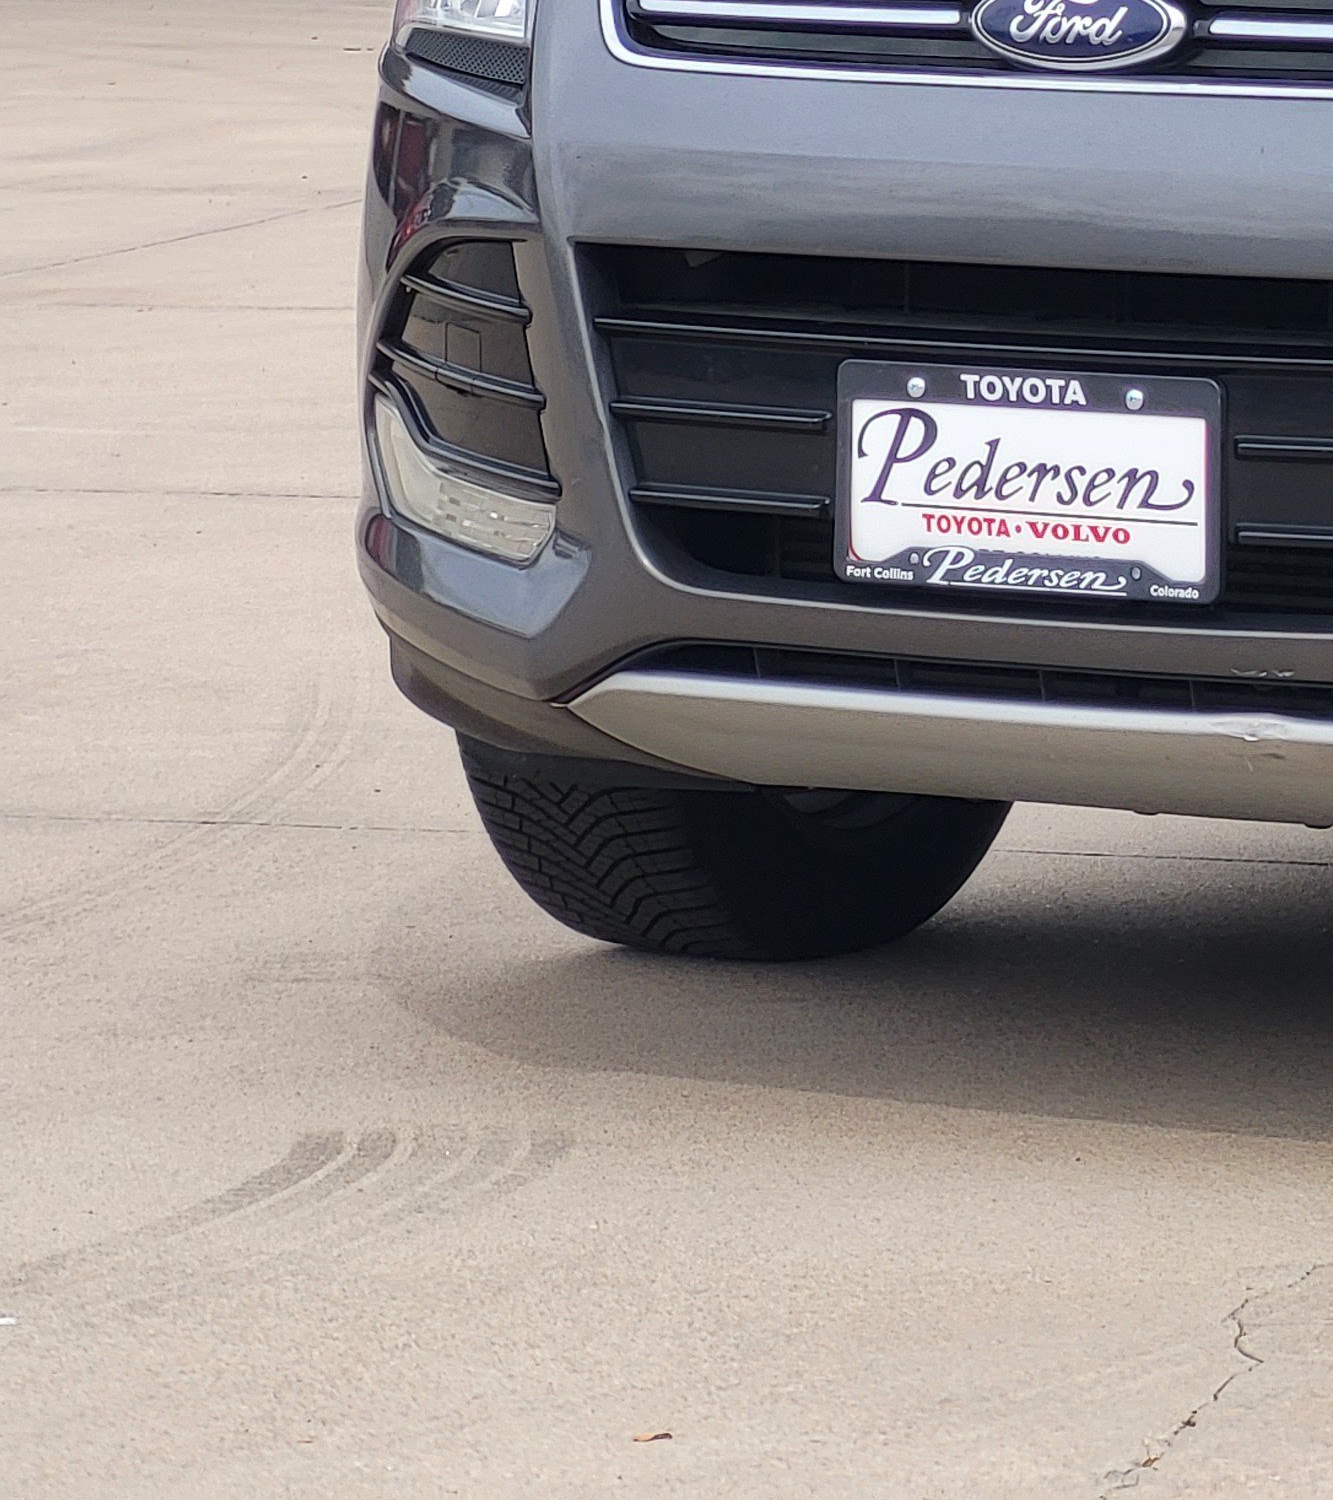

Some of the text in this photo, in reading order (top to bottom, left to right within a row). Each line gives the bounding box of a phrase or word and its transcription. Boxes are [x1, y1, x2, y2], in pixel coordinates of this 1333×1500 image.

[960, 373, 1087, 406] TOYOTA
[857, 407, 1195, 511] Pedersen
[922, 513, 1131, 544] TOYOTA VOLVO
[846, 565, 914, 581] Fort Collins
[922, 545, 1128, 591] Pedersen
[1149, 583, 1200, 600] Colorado
